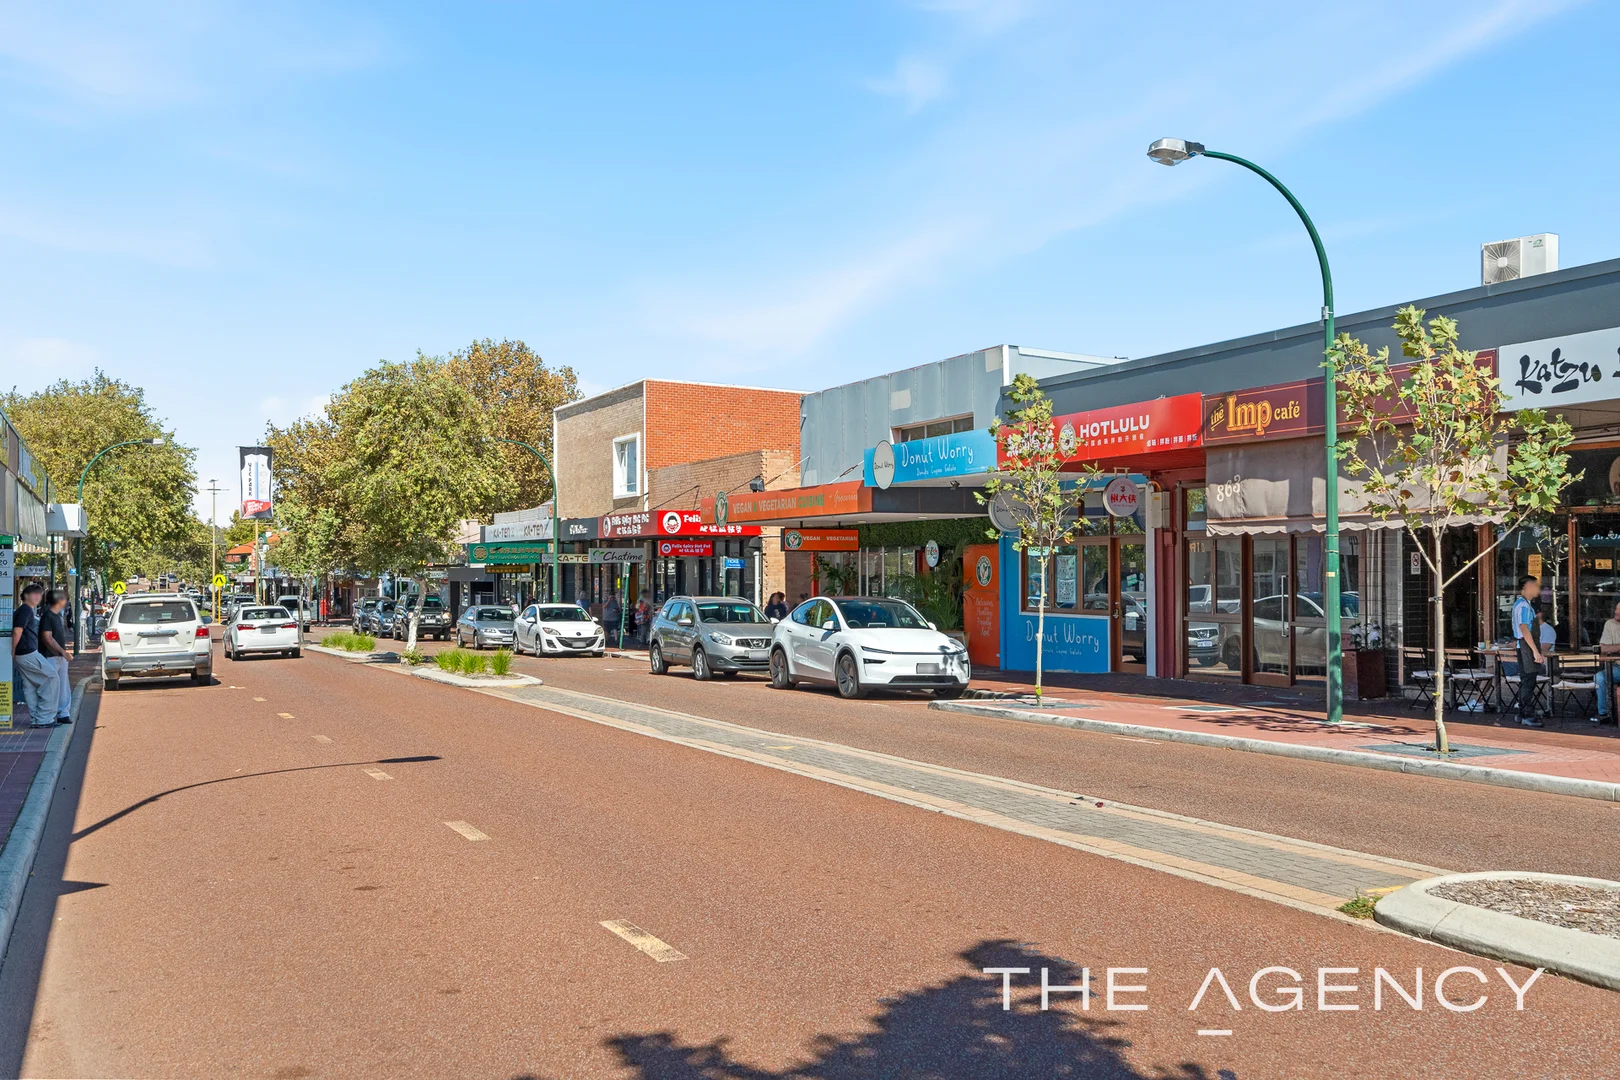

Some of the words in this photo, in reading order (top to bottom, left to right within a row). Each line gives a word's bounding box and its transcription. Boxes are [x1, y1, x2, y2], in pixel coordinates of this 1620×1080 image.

[1515, 347, 1602, 396] Katzu
[1080, 414, 1150, 439] HOTLULU
[1210, 405, 1225, 426] the
[1226, 395, 1272, 436] Imp
[1274, 400, 1300, 421] café
[901, 443, 933, 468] Donut
[937, 436, 974, 465] Worry
[1216, 475, 1241, 502] 863
[732, 501, 753, 515] VEGAN
[758, 497, 797, 512] VEGETARIAN
[797, 493, 825, 508] CUISINE
[603, 551, 644, 562] Chatime
[1063, 623, 1100, 653] Worry
